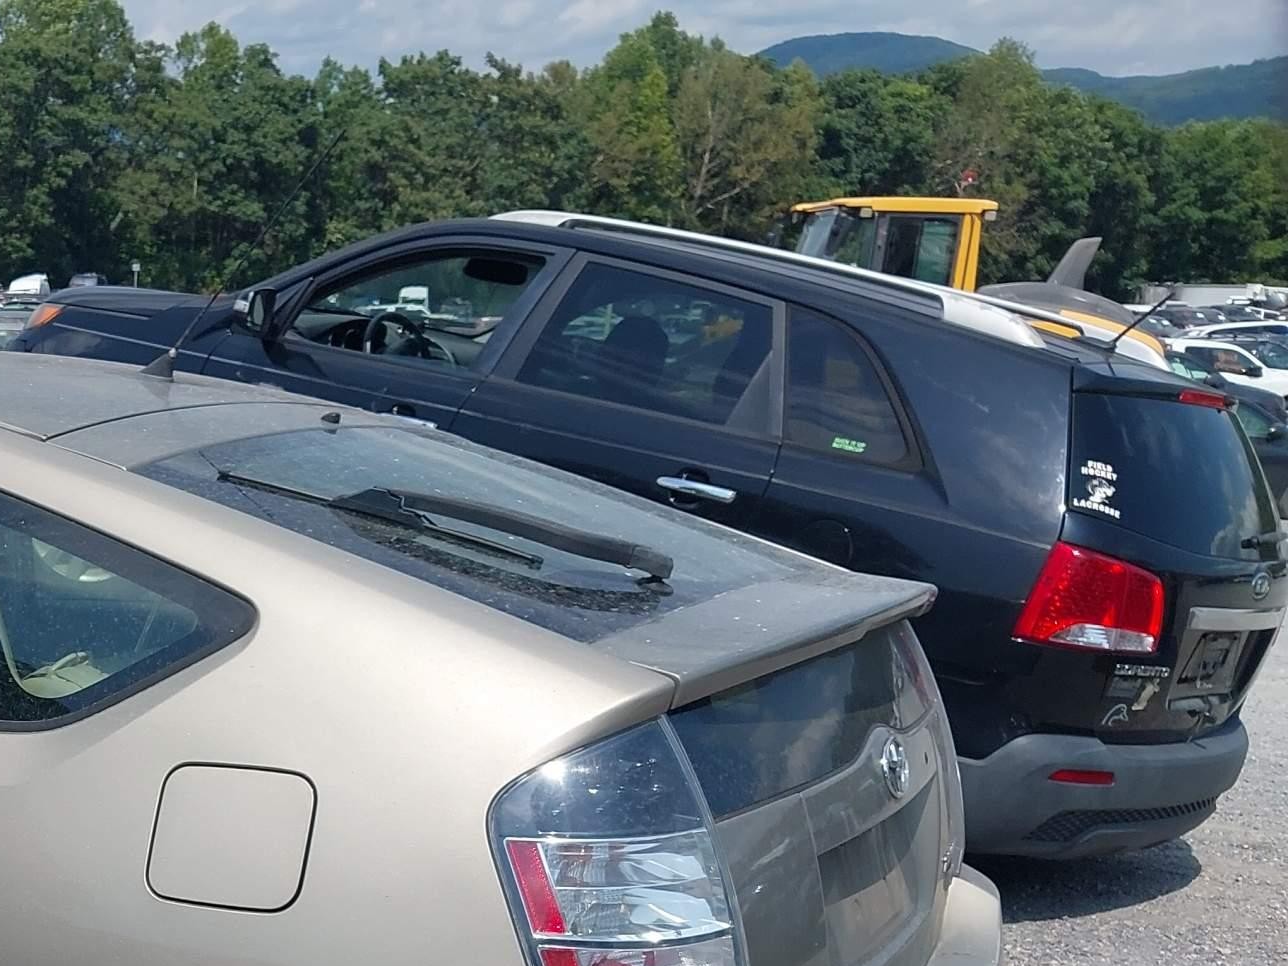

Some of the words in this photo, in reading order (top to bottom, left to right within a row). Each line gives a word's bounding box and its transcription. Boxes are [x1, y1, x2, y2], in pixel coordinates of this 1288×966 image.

[1081, 466, 1118, 481] HOCKEY
[1087, 460, 1113, 472] FIELD
[1073, 497, 1120, 519] LACROSSE
